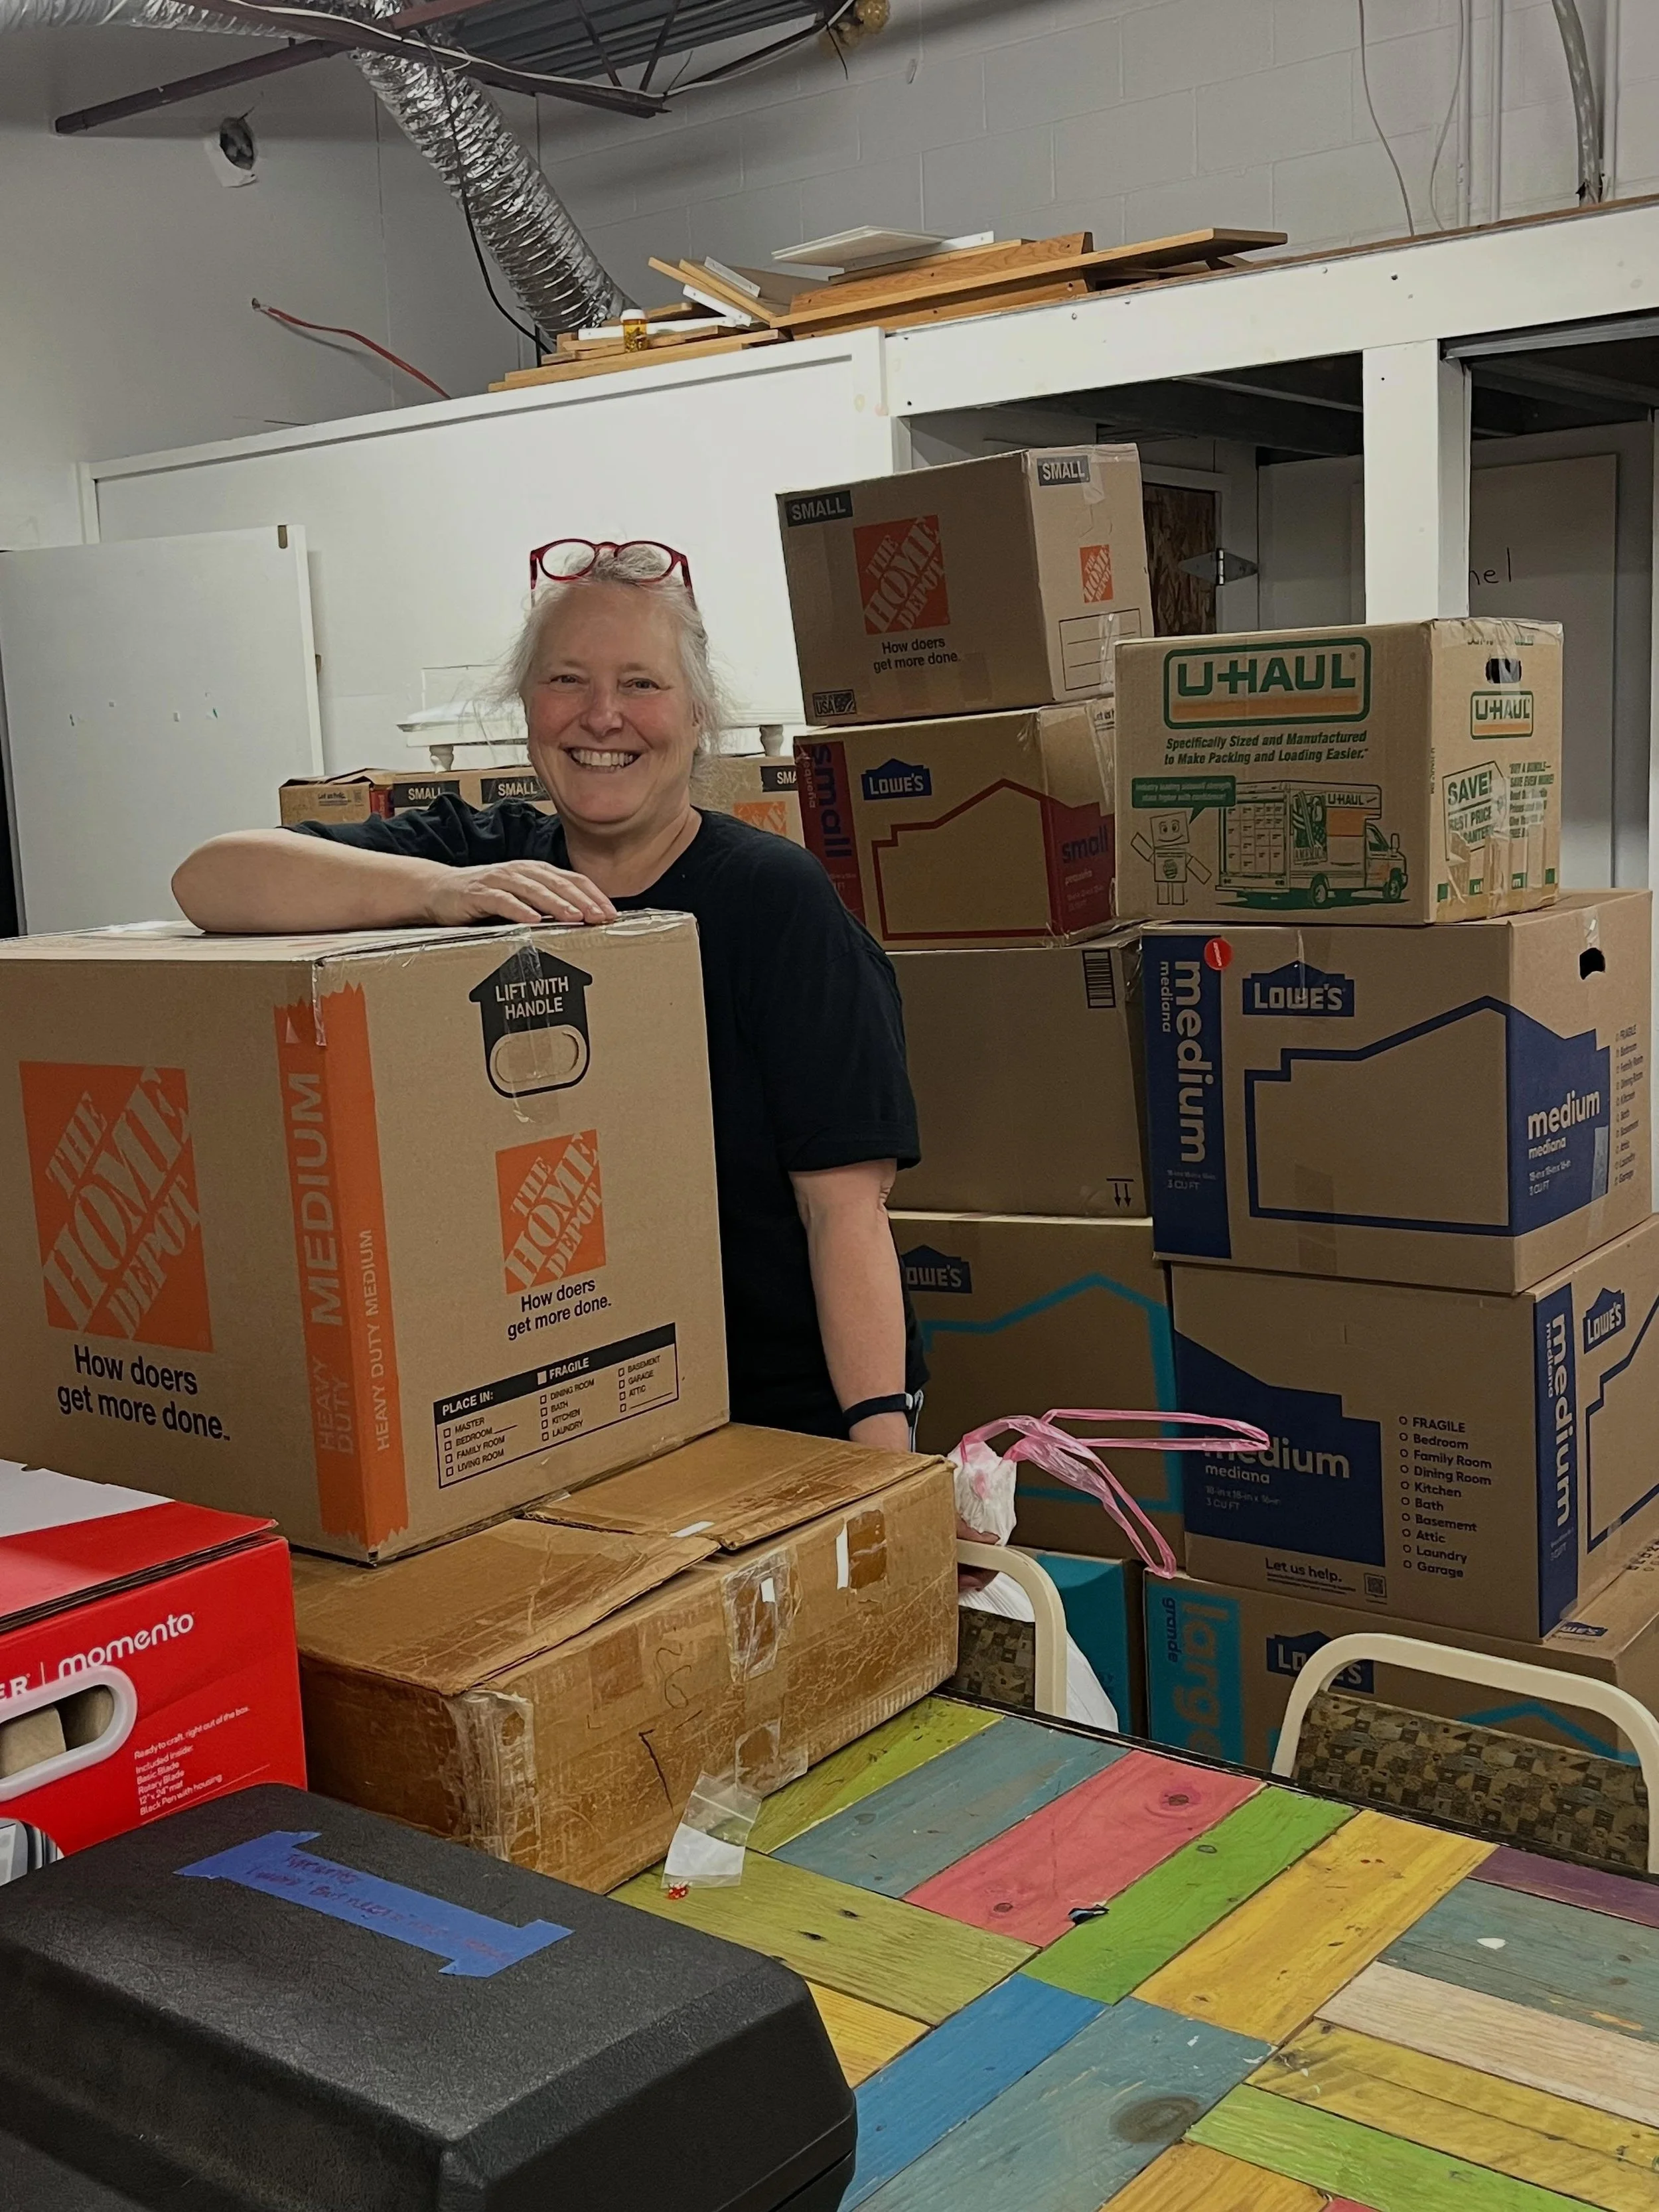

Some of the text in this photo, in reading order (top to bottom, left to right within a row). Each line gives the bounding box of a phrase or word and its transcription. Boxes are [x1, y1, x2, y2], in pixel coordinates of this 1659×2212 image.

[1042, 460, 1085, 481] SMALL
[791, 496, 847, 521] SMALL
[865, 535, 899, 579] THE
[864, 517, 940, 632] HOME
[898, 557, 945, 629] DEPOT
[882, 638, 946, 654] How doers
[873, 660, 892, 674] get
[895, 655, 924, 668] more
[816, 700, 834, 714] USA
[1167, 731, 1367, 751] Specifically Sized and Manufactured
[1165, 753, 1174, 765] to
[1178, 753, 1205, 765] Make
[1208, 751, 1251, 765] Packing
[1254, 750, 1275, 762] and
[1278, 749, 1323, 763] Loading
[498, 782, 538, 796] SMALL
[869, 774, 924, 795] LOWE'S
[1448, 770, 1492, 806] SAVE!
[812, 745, 852, 857] small
[1062, 824, 1108, 863] small
[495, 976, 569, 1002] LIFT WITH
[1160, 962, 1173, 1033] mediana
[1254, 982, 1342, 1011] LOWE'S
[504, 996, 563, 1020] HANDLE
[1175, 961, 1214, 1163] medium
[1528, 1089, 1600, 1141] medium
[45, 1090, 107, 1200] THE
[1528, 1137, 1567, 1160] mediana
[510, 1156, 551, 1217] THE
[42, 1067, 190, 1333] HOME
[289, 1072, 344, 1327] MEDIUM
[504, 1132, 599, 1288] HOME
[546, 1182, 602, 1280] DEPOT
[106, 1173, 199, 1339] DEPOT
[905, 1264, 962, 1288] OWE'S
[521, 1280, 595, 1313] How doers
[508, 1295, 612, 1341] get more done.
[1587, 1301, 1622, 1344] LOWE'S
[359, 1228, 390, 1451] HEAVY DUTY MEDIUM
[74, 1344, 198, 1395] How doers
[549, 1357, 589, 1380] FRAGILE
[628, 1355, 661, 1372] BASEMENT
[550, 1378, 595, 1400] DINING ROOM
[628, 1370, 654, 1384] GARAGE
[312, 1355, 336, 1449] HEAVY
[628, 1384, 646, 1397] ATTIC
[57, 1385, 93, 1415] get
[98, 1394, 157, 1426] more
[332, 1375, 354, 1455] DUTY
[442, 1390, 494, 1416] PLACE IN:
[551, 1401, 569, 1413] BATH
[455, 1417, 485, 1434] MASTER
[552, 1408, 581, 1424] KITCHEN
[1412, 1417, 1466, 1434] FRAGILE
[1551, 1313, 1573, 1527] medium
[456, 1427, 492, 1447] BEDROOM
[552, 1420, 583, 1438] LAUNDRY
[457, 1435, 505, 1459] FAMILY ROOM
[1413, 1434, 1469, 1450] Bedroom
[457, 1448, 504, 1472] LIVING ROOM
[1204, 1436, 1350, 1479] dium
[1413, 1449, 1492, 1469] Family Room
[1205, 1465, 1270, 1484] mediana
[1414, 1465, 1492, 1486] Dining Room
[1415, 1481, 1462, 1498] Kitchen
[1206, 1498, 1241, 1511] 3 CU FT
[1415, 1497, 1444, 1511] Bath
[1415, 1513, 1478, 1532] Basement
[1416, 1530, 1447, 1543] Attic
[1416, 1545, 1468, 1565] Laundry
[1265, 1557, 1289, 1572] Let
[1290, 1565, 1305, 1575] us
[1309, 1566, 1342, 1583] help.
[1417, 1561, 1464, 1579] Garage
[1162, 1597, 1182, 1662] grande
[58, 1613, 194, 1680] momento
[134, 1745, 158, 1759] Ready
[185, 1725, 202, 1738] right
[203, 1720, 216, 1730] out
[223, 1712, 235, 1722] the
[135, 1752, 169, 1774] Included
[137, 1762, 180, 1785] Basic Blade
[138, 1770, 184, 1795] Rotary Blade
[169, 1780, 183, 1792] mat
[140, 1774, 223, 1816] Black Pen with housing
